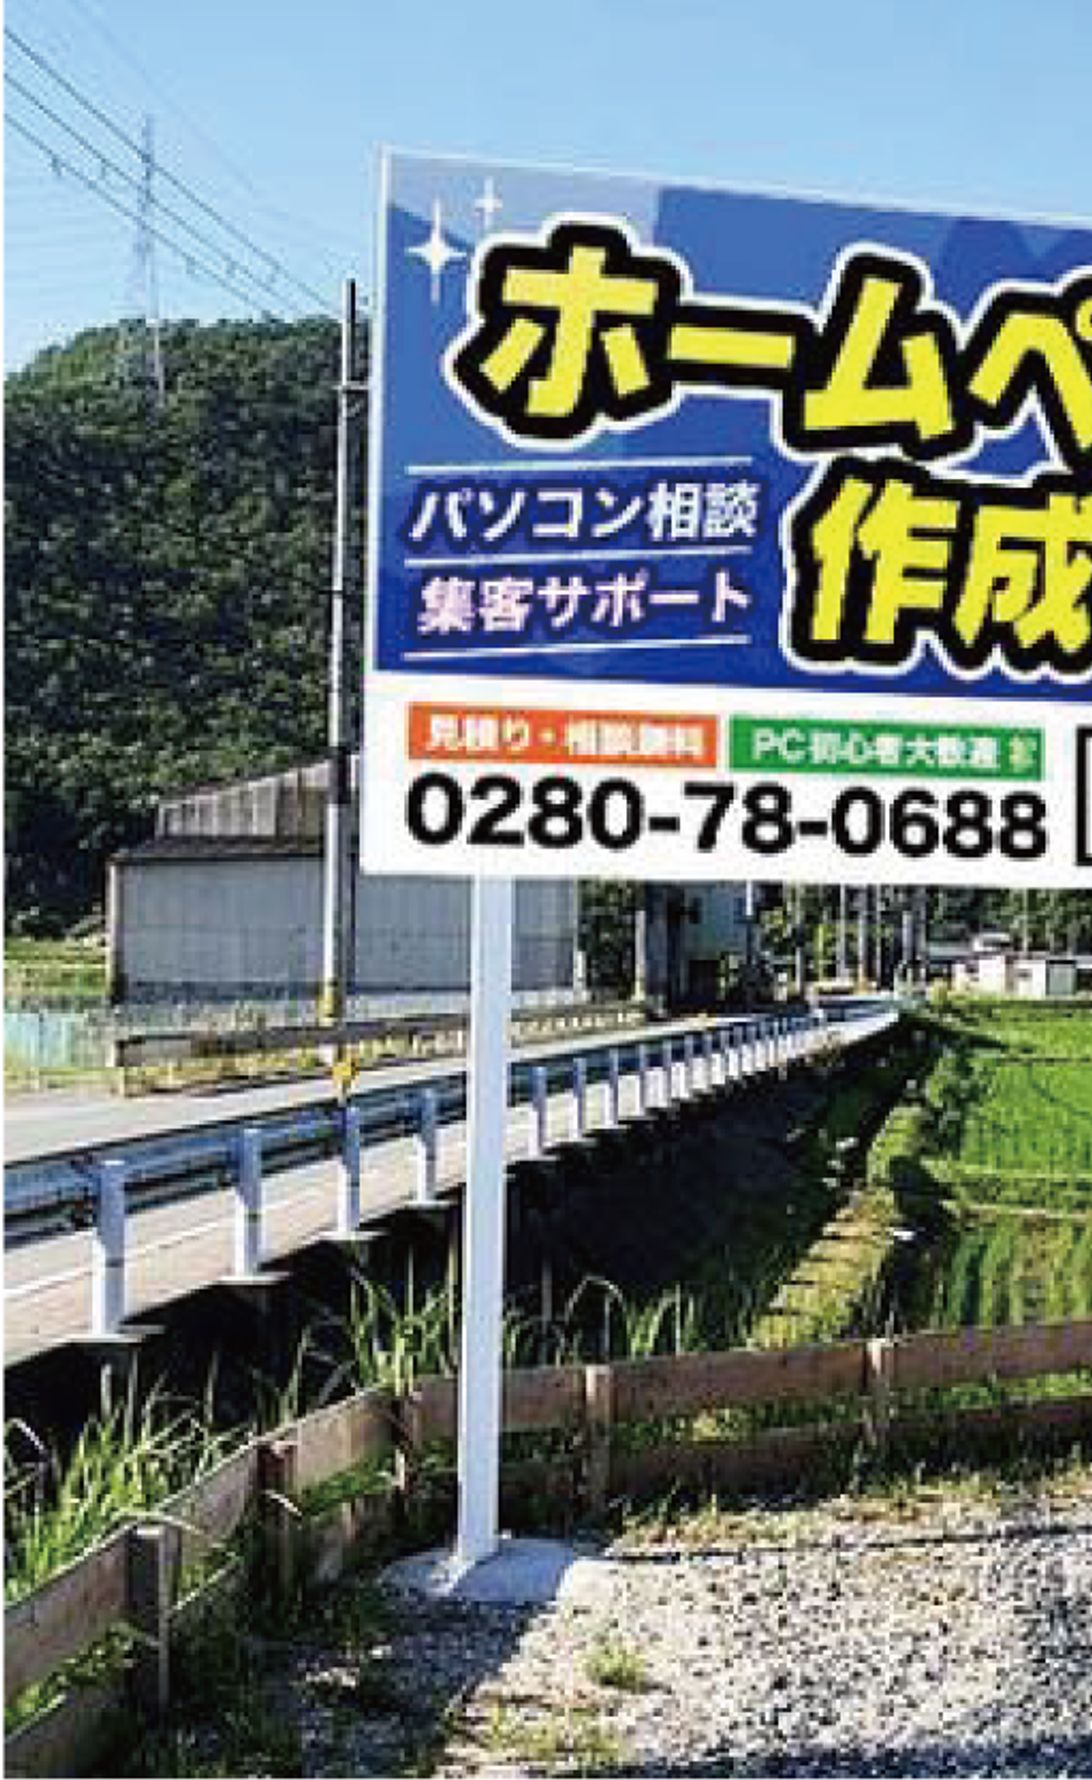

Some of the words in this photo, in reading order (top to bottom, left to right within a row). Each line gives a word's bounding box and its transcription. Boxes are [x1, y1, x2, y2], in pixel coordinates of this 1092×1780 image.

[409, 480, 759, 541] パソコン相談
[417, 570, 752, 635] 集客サポート
[406, 772, 1048, 859] 0280-78-0688
